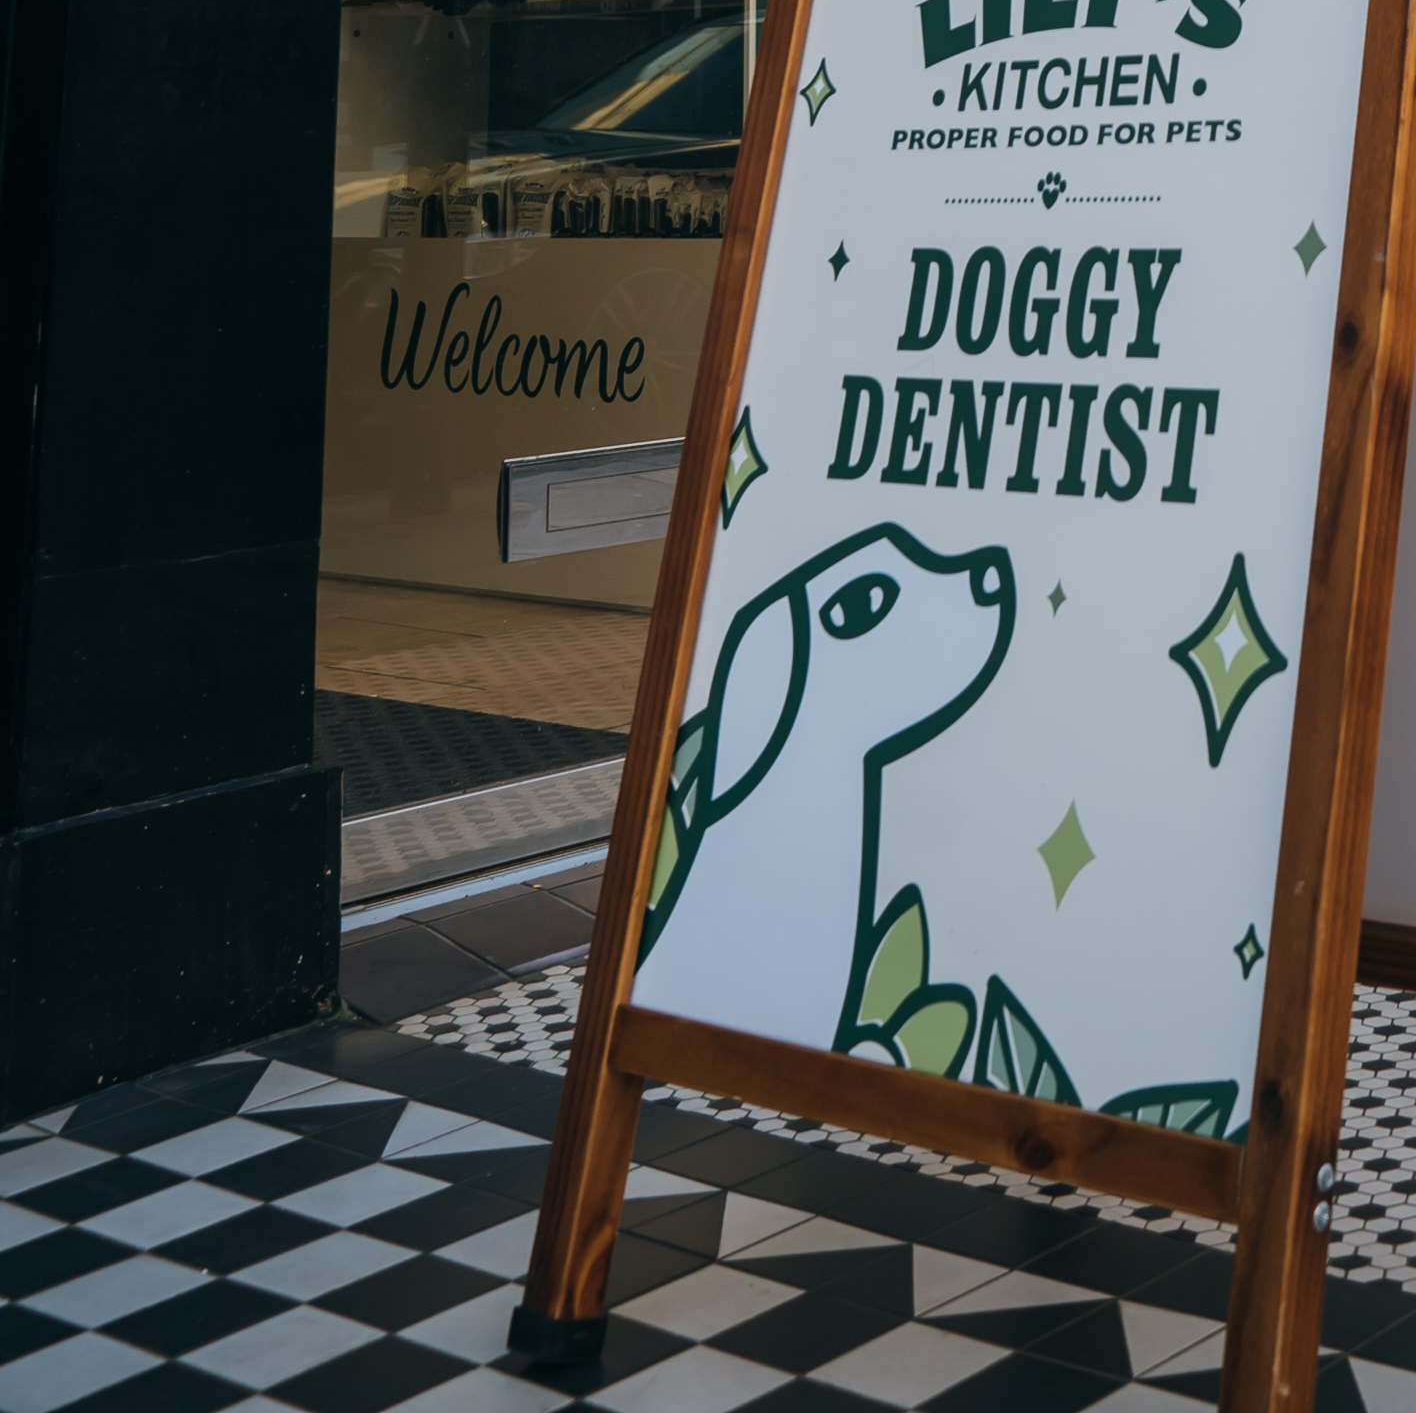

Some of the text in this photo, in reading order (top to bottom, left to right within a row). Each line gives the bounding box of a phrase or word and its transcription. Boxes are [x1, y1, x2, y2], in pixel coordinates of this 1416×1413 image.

[891, 118, 1244, 151] PROPER FOOD FOR PETS
[956, 52, 1181, 113] KITCHEN
[379, 281, 646, 404] Welcome
[896, 244, 1183, 360] DOGGY
[826, 374, 1221, 505] DENTIST
